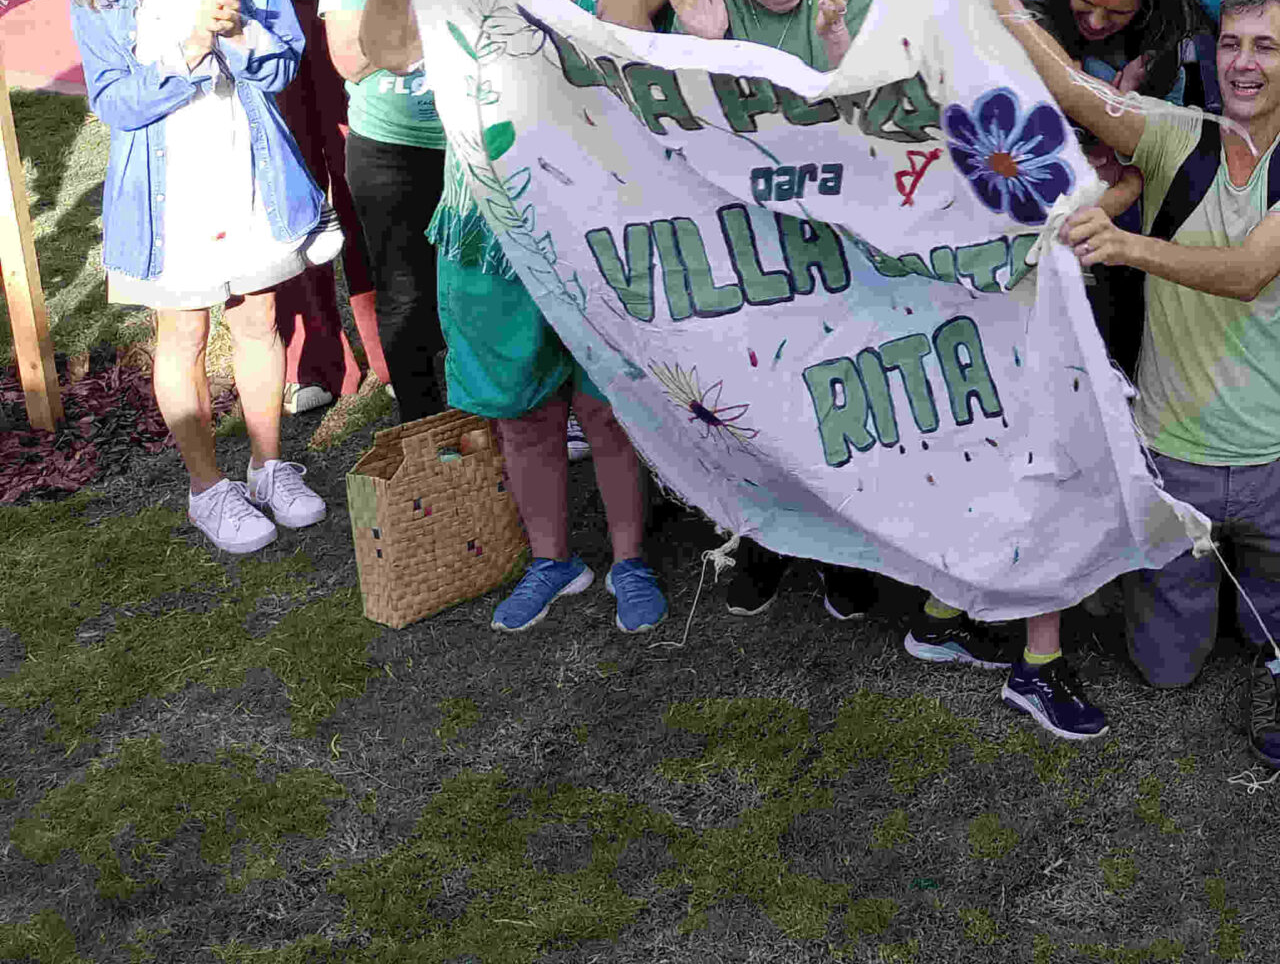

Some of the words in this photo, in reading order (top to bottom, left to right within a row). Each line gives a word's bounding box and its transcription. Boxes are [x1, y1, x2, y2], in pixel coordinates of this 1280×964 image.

[378, 74, 430, 96] FLO
[585, 202, 852, 323] VILLA
[802, 315, 1004, 467] RITA
